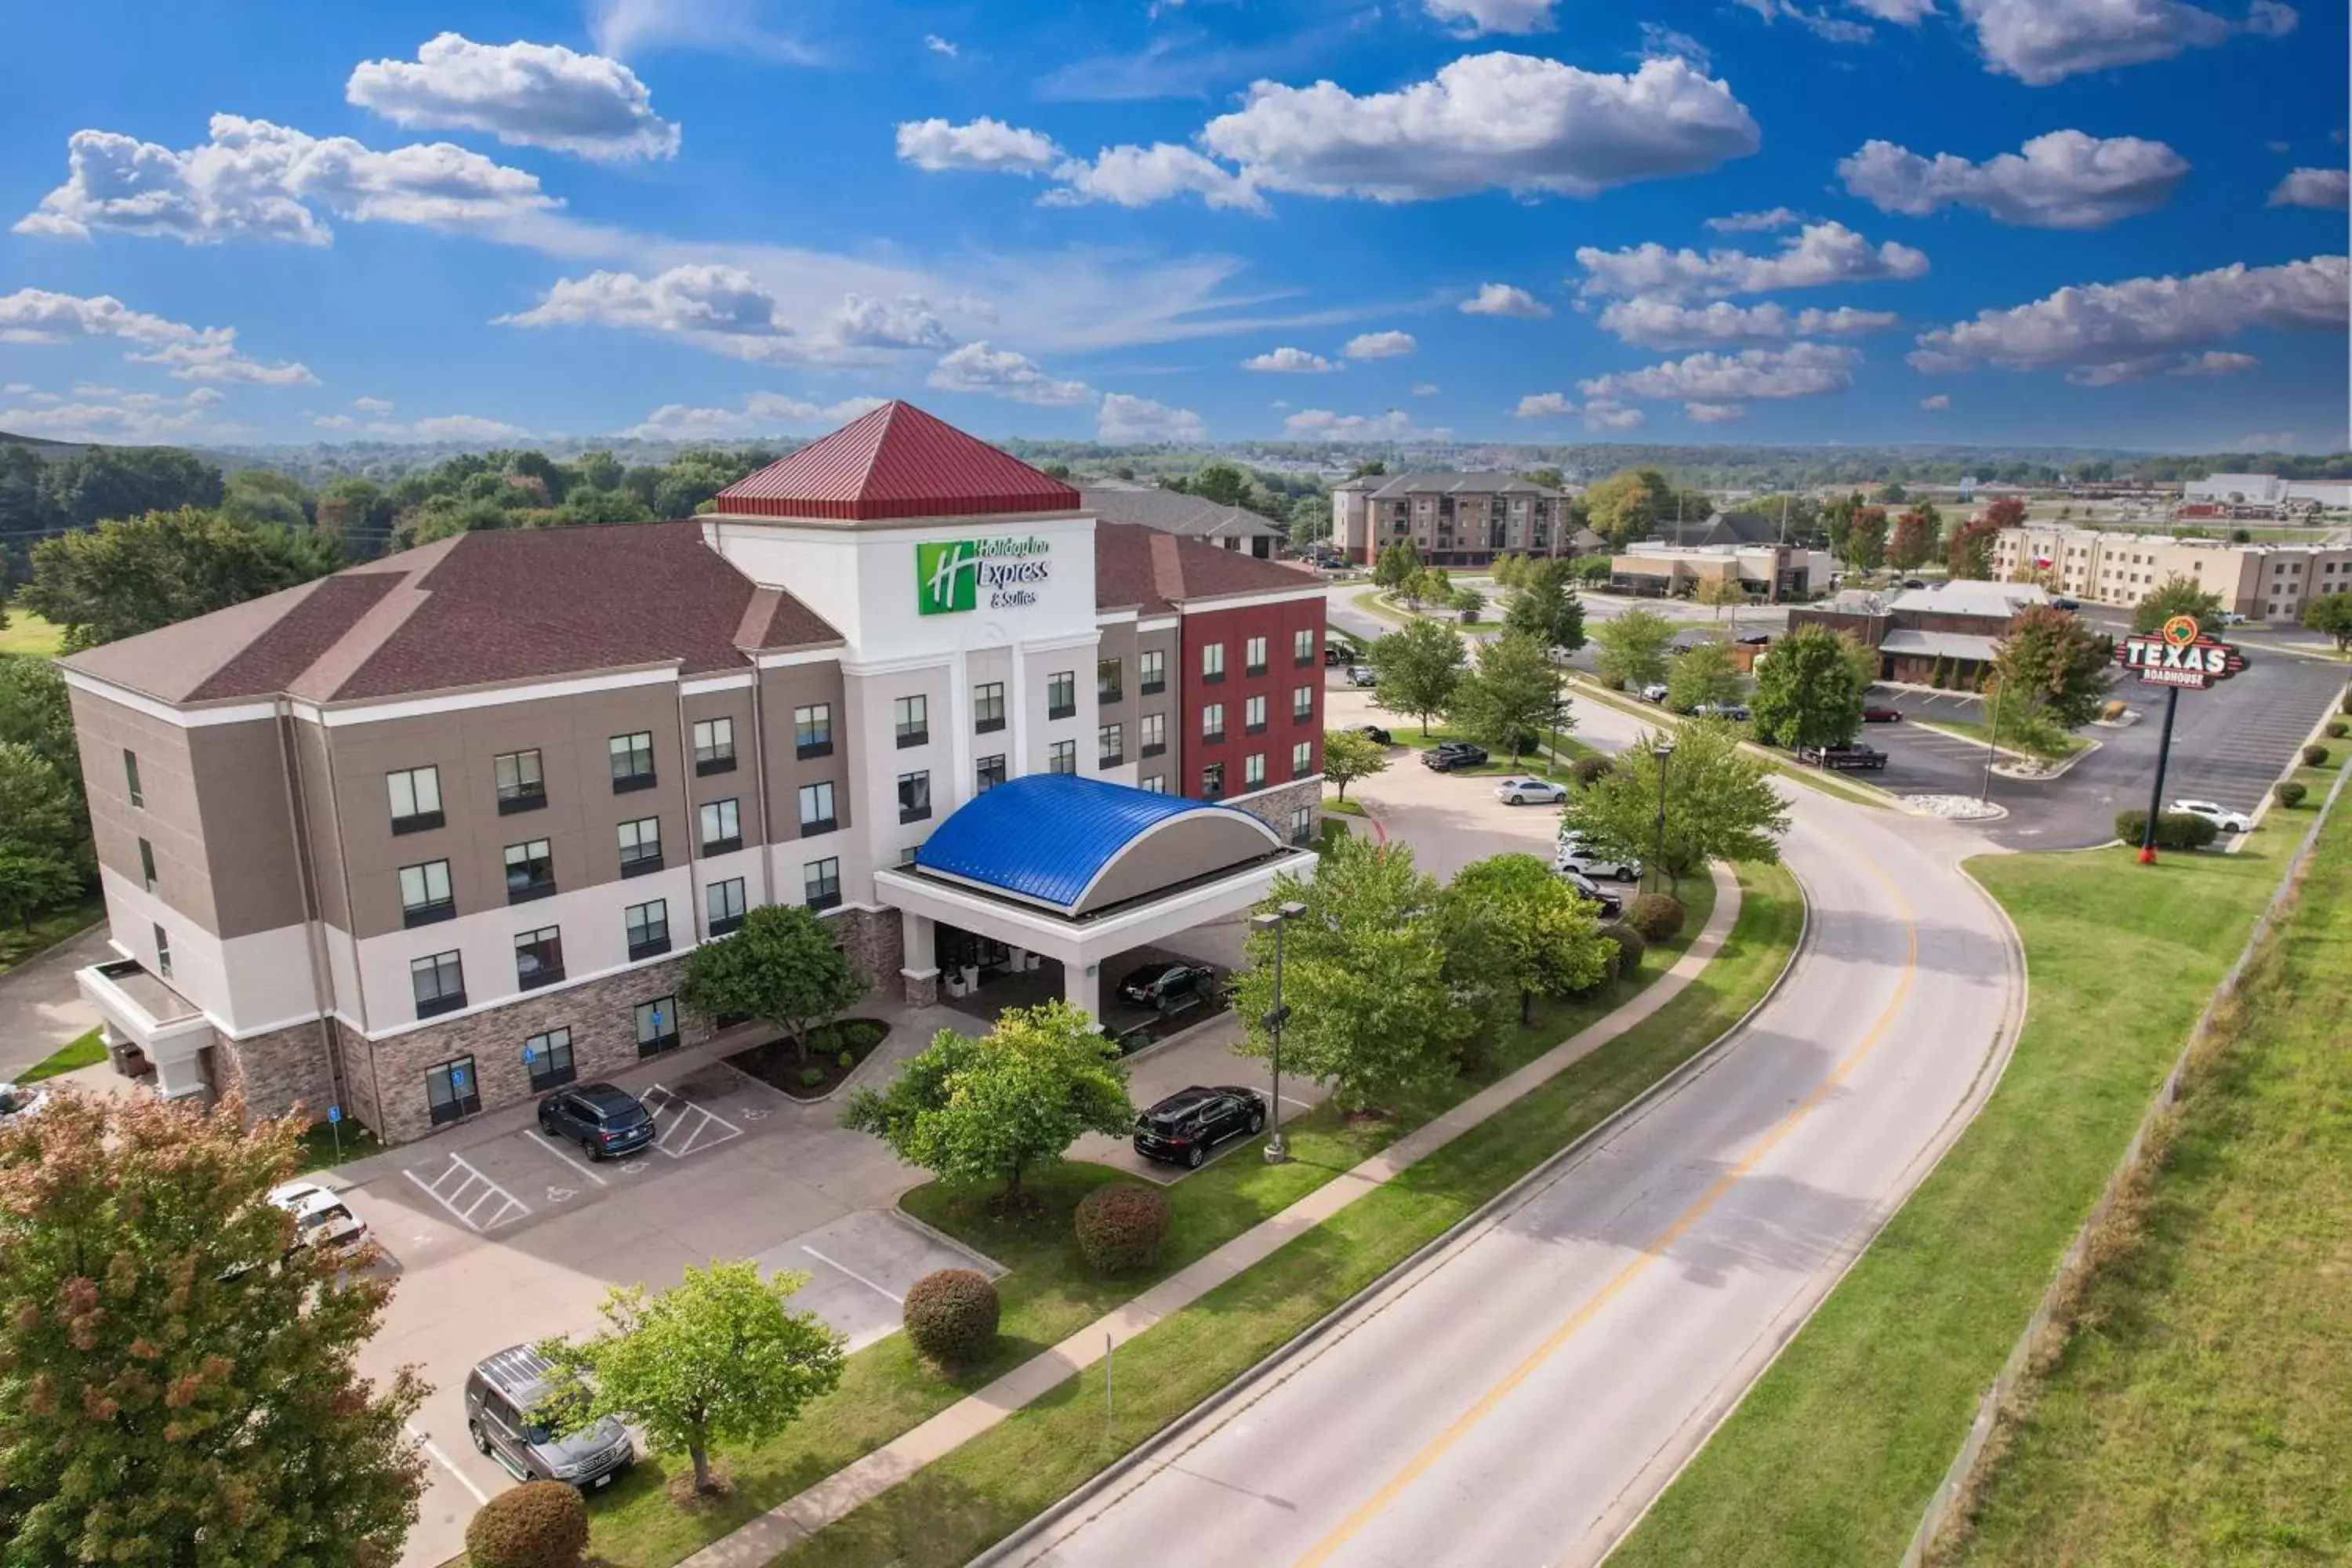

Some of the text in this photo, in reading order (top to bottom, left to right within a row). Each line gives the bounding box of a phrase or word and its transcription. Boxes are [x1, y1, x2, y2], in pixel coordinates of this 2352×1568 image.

[976, 560, 1050, 590] Express
[990, 590, 1037, 609] & Suites
[2127, 641, 2226, 673] TEXAS
[2143, 669, 2204, 686] ROADHOUSE
